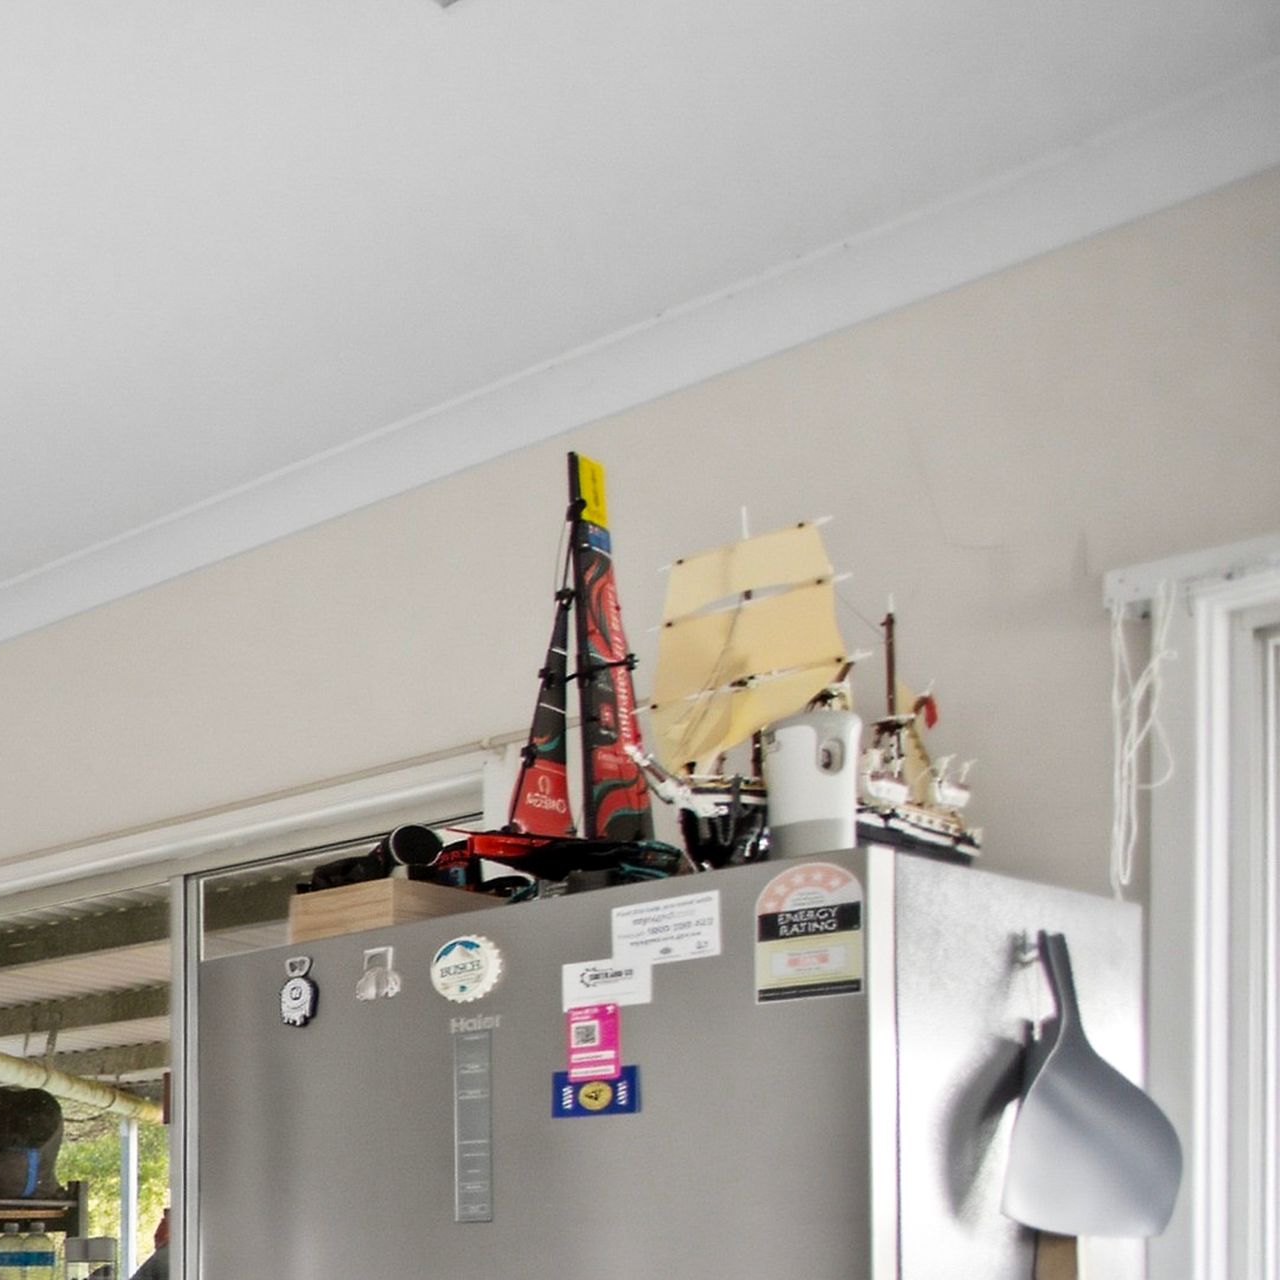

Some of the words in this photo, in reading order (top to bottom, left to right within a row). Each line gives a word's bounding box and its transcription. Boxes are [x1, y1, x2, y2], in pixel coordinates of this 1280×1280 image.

[777, 906, 839, 926] ENERGY
[779, 920, 837, 937] RATING
[450, 1013, 501, 1034] Haier
